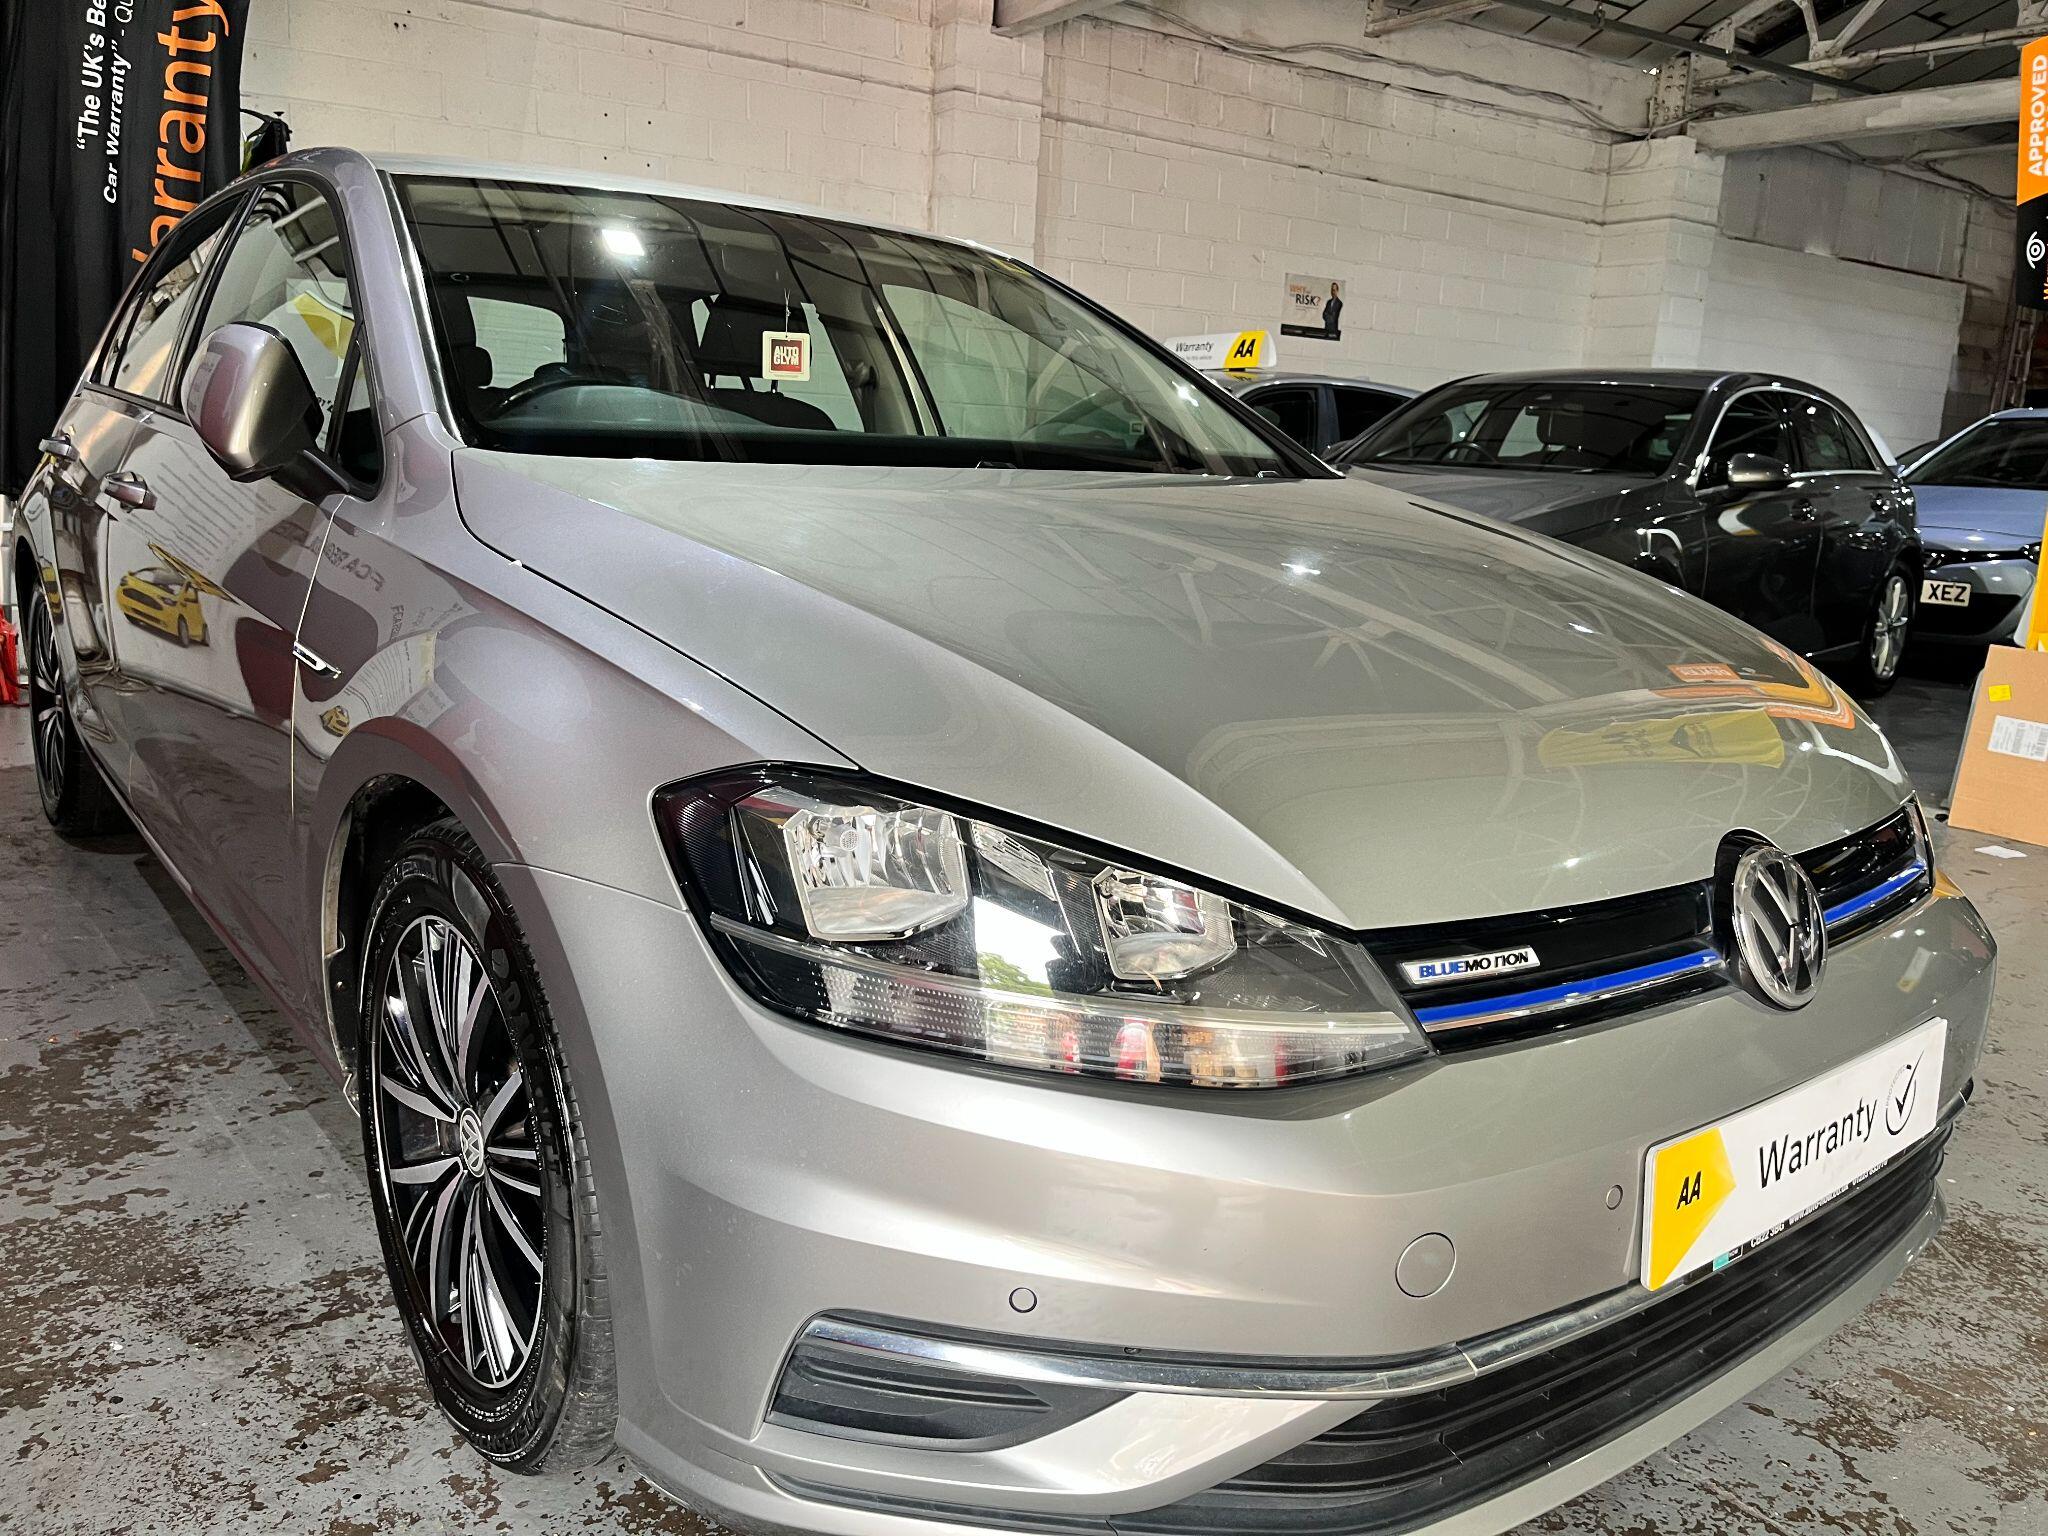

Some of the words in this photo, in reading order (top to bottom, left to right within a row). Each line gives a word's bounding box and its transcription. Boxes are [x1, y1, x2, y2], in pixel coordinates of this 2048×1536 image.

[2028, 54, 2048, 177] APPROVED
[132, 0, 230, 263] arranty
[103, 162, 118, 204] Car
[1295, 293, 1321, 306] RISK?
[774, 345, 799, 356] AUTO
[1175, 341, 1215, 353] Warranty
[1233, 338, 1256, 359] AA
[773, 354, 799, 366] GLYM
[1928, 583, 1968, 603] XEZ
[1418, 951, 1529, 979] BLUEMOTION
[1759, 1096, 1878, 1189] Warranty
[1676, 1171, 1702, 1211] AA
